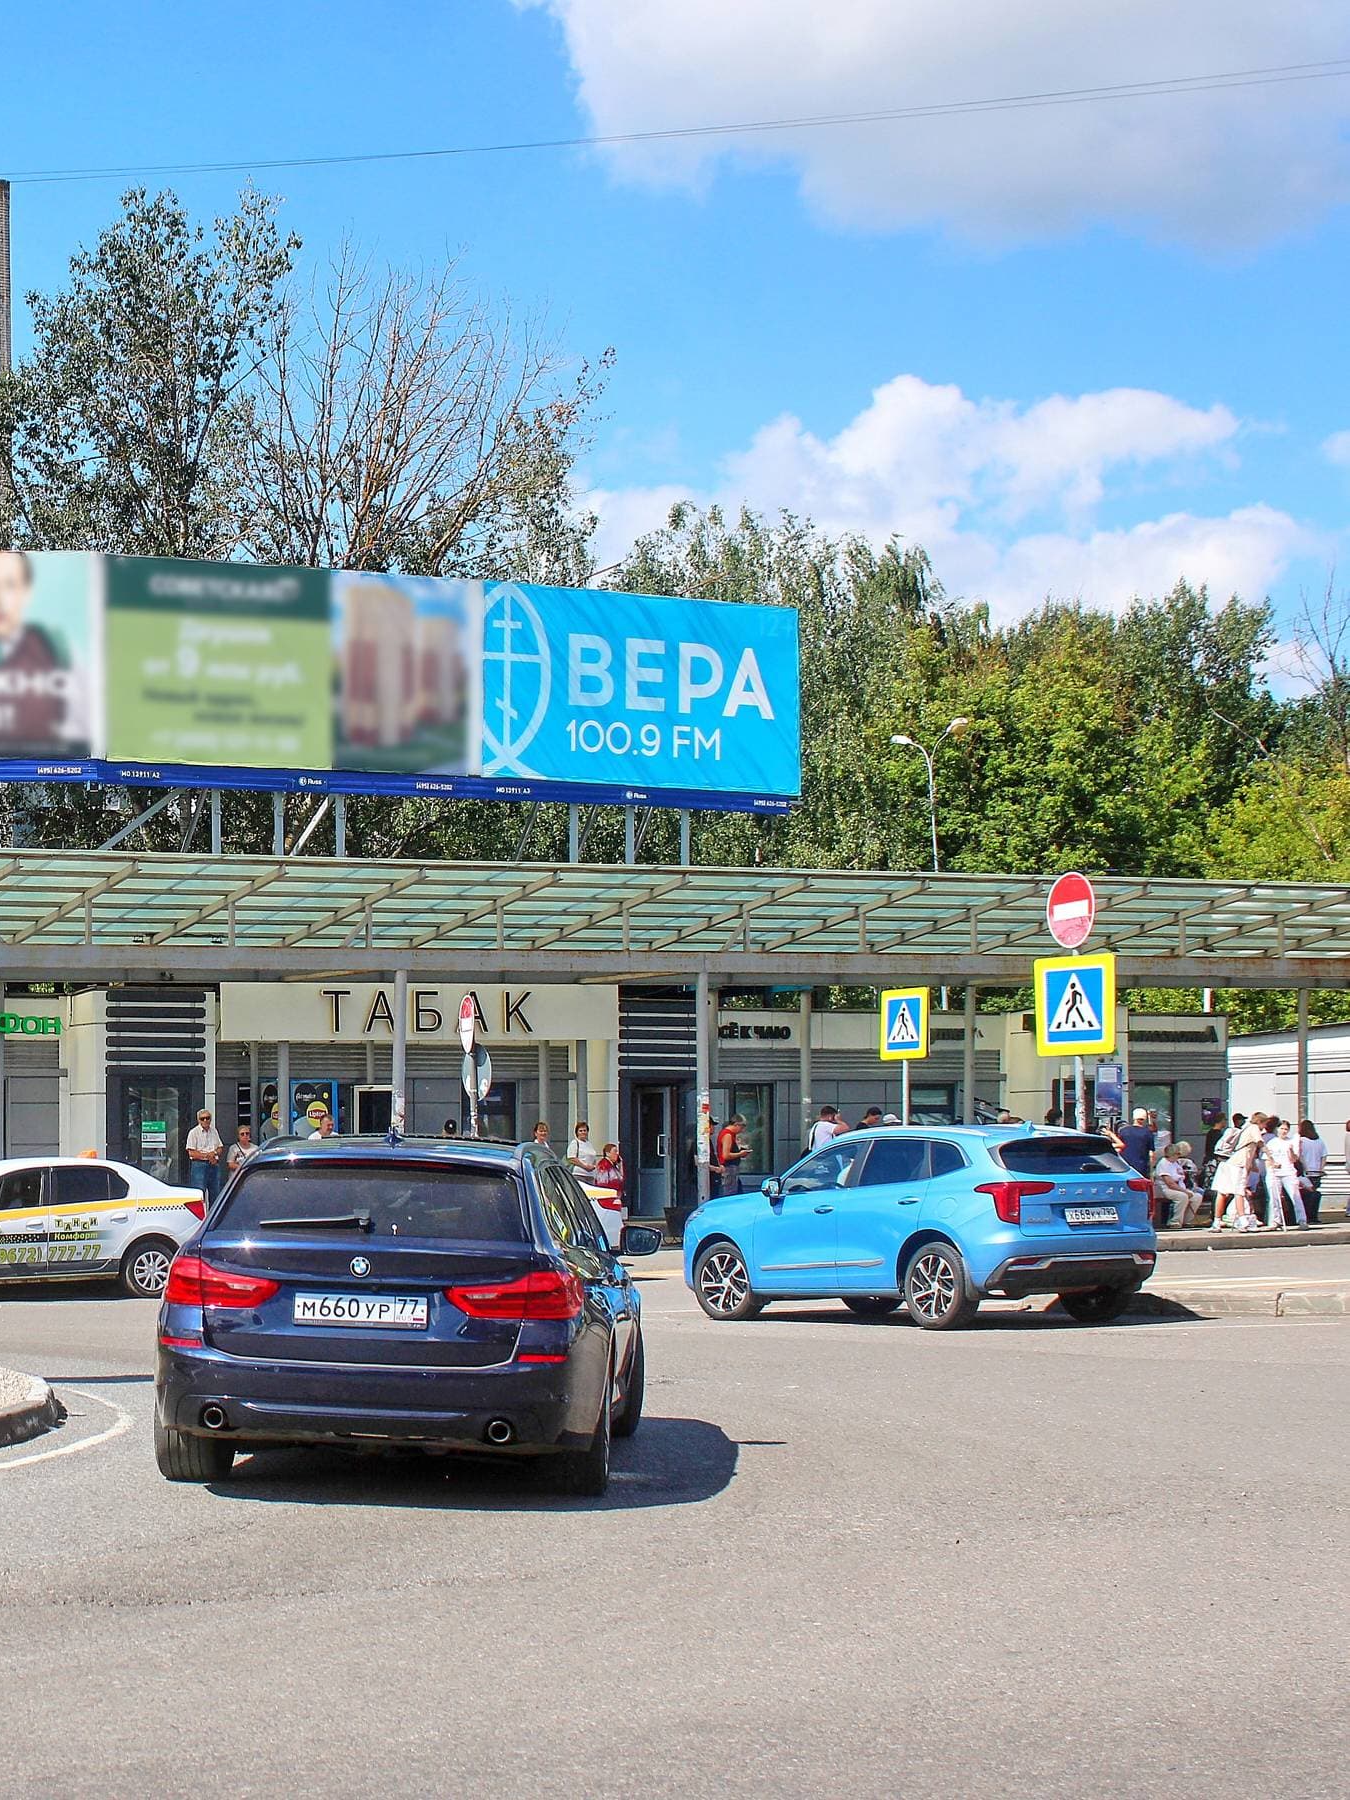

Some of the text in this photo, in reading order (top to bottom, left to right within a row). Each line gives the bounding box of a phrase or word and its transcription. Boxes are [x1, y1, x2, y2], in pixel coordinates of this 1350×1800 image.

[568, 633, 775, 720] ВЕРА
[566, 719, 721, 761] 100.9 FM
[302, 1296, 420, 1320] М660УР 77
